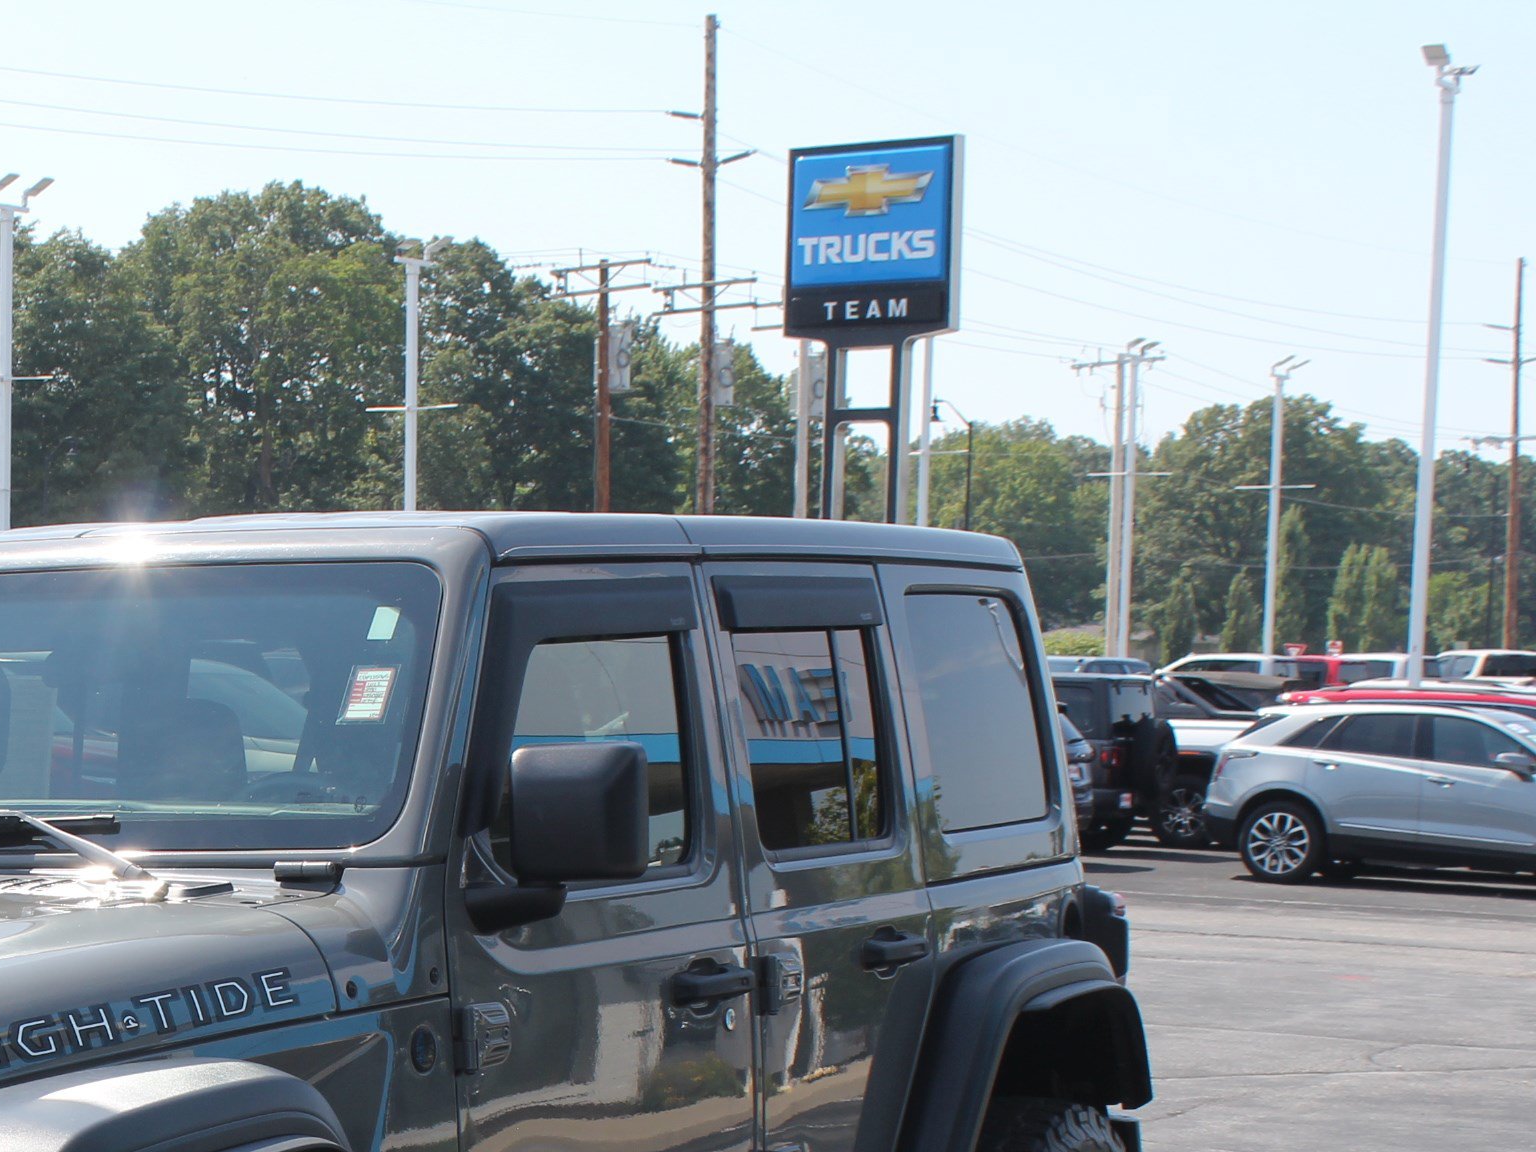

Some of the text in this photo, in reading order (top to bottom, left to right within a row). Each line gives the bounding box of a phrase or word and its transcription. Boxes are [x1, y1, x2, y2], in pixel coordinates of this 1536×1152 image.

[797, 229, 936, 266] TRUCKS
[823, 298, 908, 321] TEAM
[134, 967, 298, 1034] TIDE
